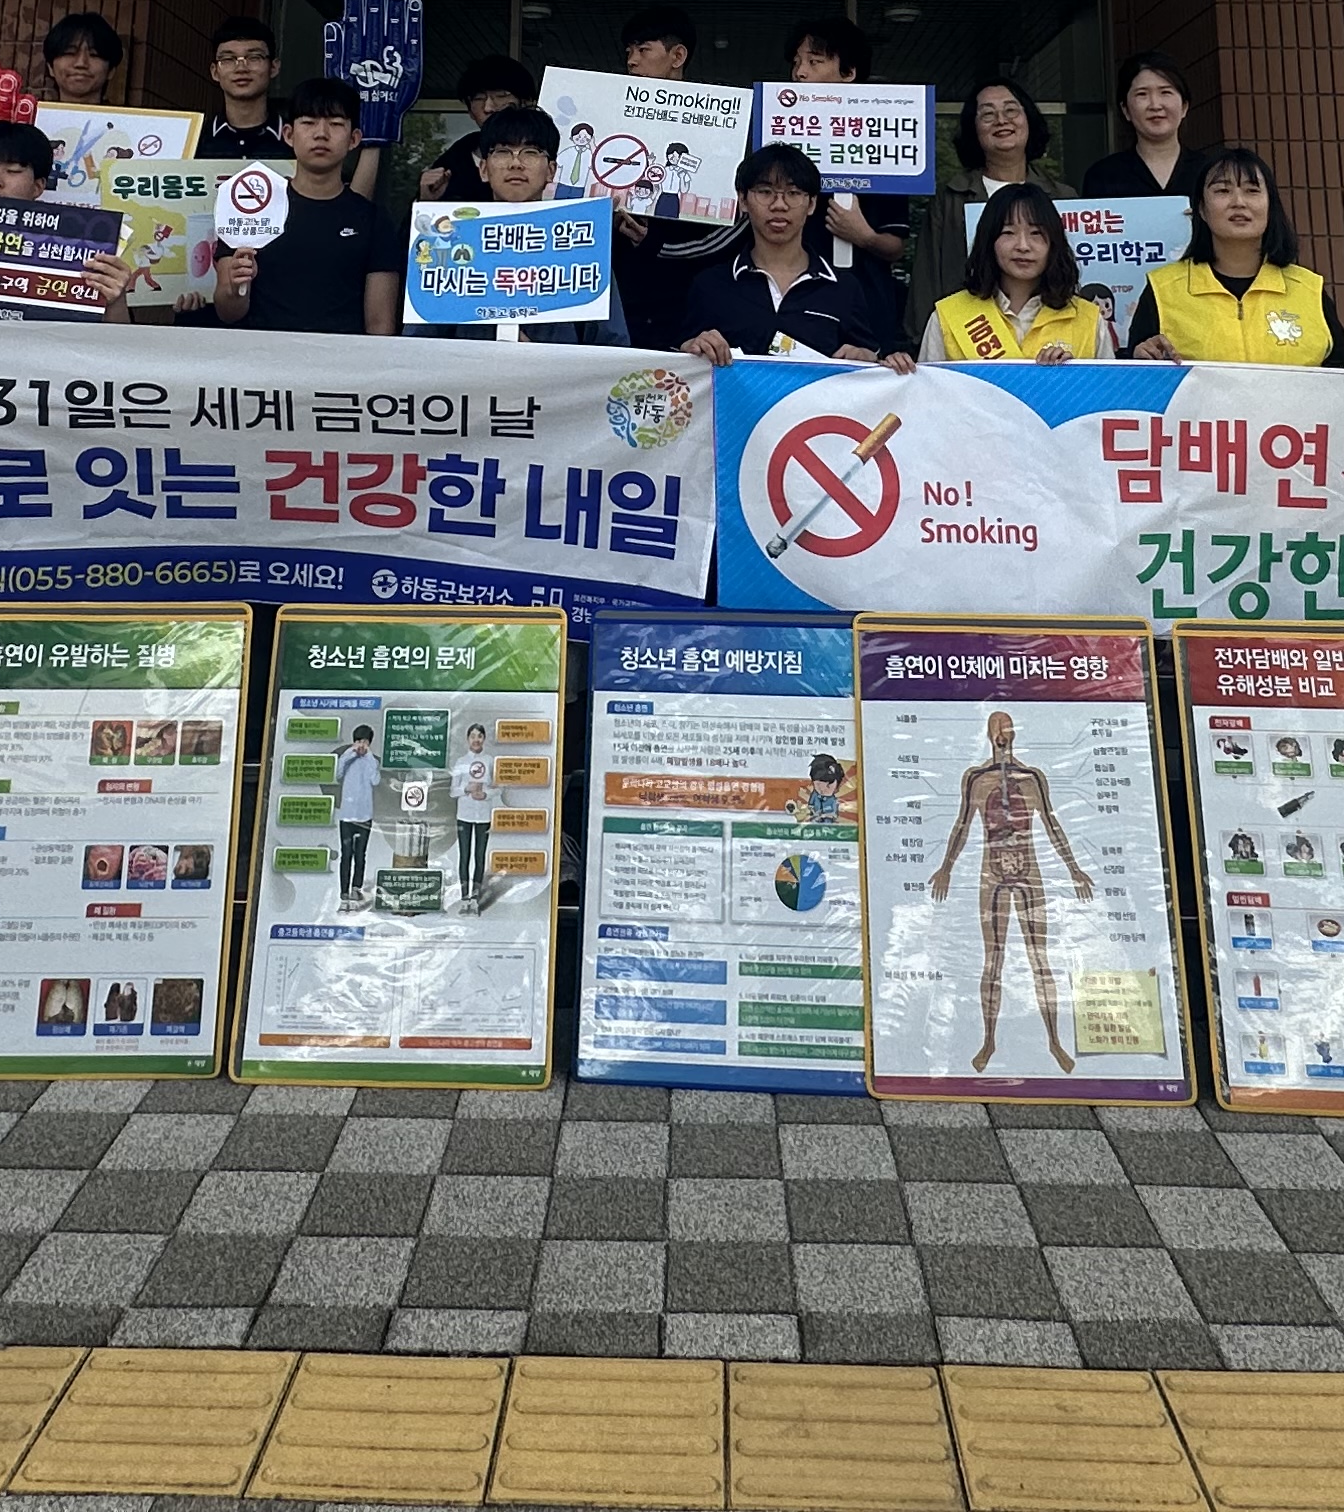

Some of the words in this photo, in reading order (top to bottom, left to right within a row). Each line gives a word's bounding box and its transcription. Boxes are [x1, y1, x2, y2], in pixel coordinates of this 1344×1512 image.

[626, 86, 649, 102] No
[812, 95, 842, 104] Smoking
[624, 105, 679, 122] 전자담배도
[682, 112, 737, 129] 담배입니다
[771, 115, 822, 136] 흡연은
[829, 116, 919, 138] 질병입니다
[830, 143, 918, 165] 금연입니다
[22, 211, 59, 230] 위하여
[1061, 209, 1124, 235] 배없는
[482, 222, 547, 253] 담배는
[553, 221, 595, 249] 알고
[1075, 239, 1167, 266] 우리학교
[35, 275, 68, 298] 금연
[71, 284, 99, 300] 안내
[422, 266, 487, 296] 마시는
[495, 263, 599, 295] 독약입니다
[190, 386, 296, 432] 세계
[311, 390, 468, 437] 금연의
[489, 395, 541, 440] 날
[633, 404, 665, 424] 하동
[74, 446, 241, 522] 잇는
[264, 449, 506, 539] 건강한
[523, 463, 682, 561] 내일
[924, 481, 973, 508] No!
[921, 516, 1038, 552] Smoking
[267, 564, 345, 592] 오세요!
[400, 574, 513, 607] 하동군보건소
[49, 643, 130, 669] 유발하는
[137, 643, 176, 668] 질병
[308, 645, 366, 669] 청소년
[371, 645, 431, 670] 흡연의
[435, 646, 476, 670] 문제
[620, 647, 677, 671] 청소년
[681, 647, 720, 672] 흡연
[725, 649, 802, 675] 예방지침
[885, 655, 943, 680] 흡연이
[947, 655, 1005, 681] 인체에
[1009, 656, 1067, 681] 미치는
[1069, 656, 1109, 681] 영향
[1214, 647, 1309, 670] 전자담배와
[1216, 674, 1293, 697] 유해성분
[1298, 676, 1337, 698] 비교
